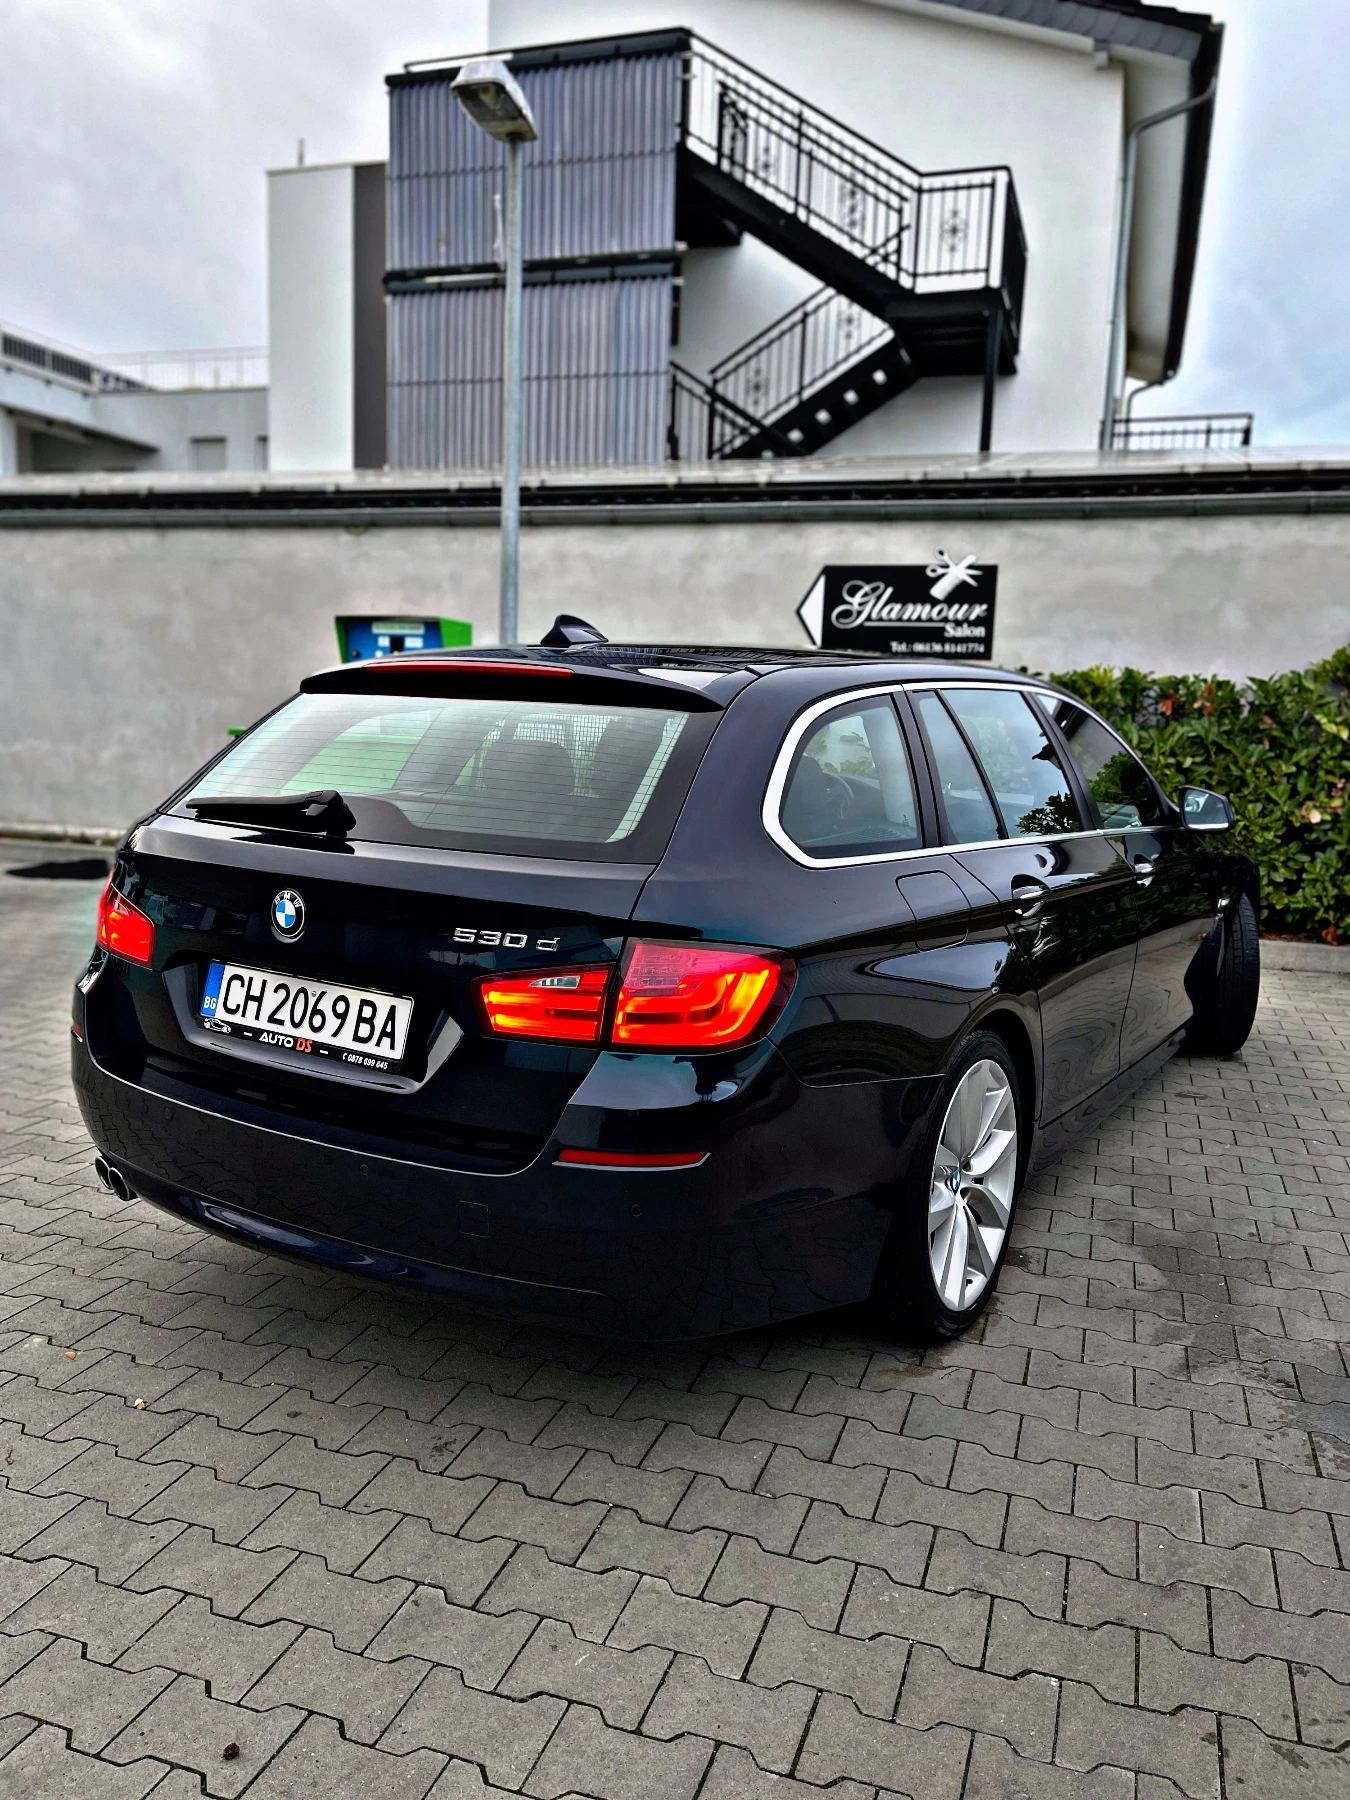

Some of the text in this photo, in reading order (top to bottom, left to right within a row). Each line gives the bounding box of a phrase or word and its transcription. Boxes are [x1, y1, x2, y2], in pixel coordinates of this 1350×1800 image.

[831, 579, 988, 629] Glamour
[944, 622, 986, 637] Salon
[453, 927, 560, 951] 530 d
[203, 996, 217, 1010] BG
[259, 1031, 313, 1053] AUTO DS
[347, 1053, 389, 1070] 0878 699 645
